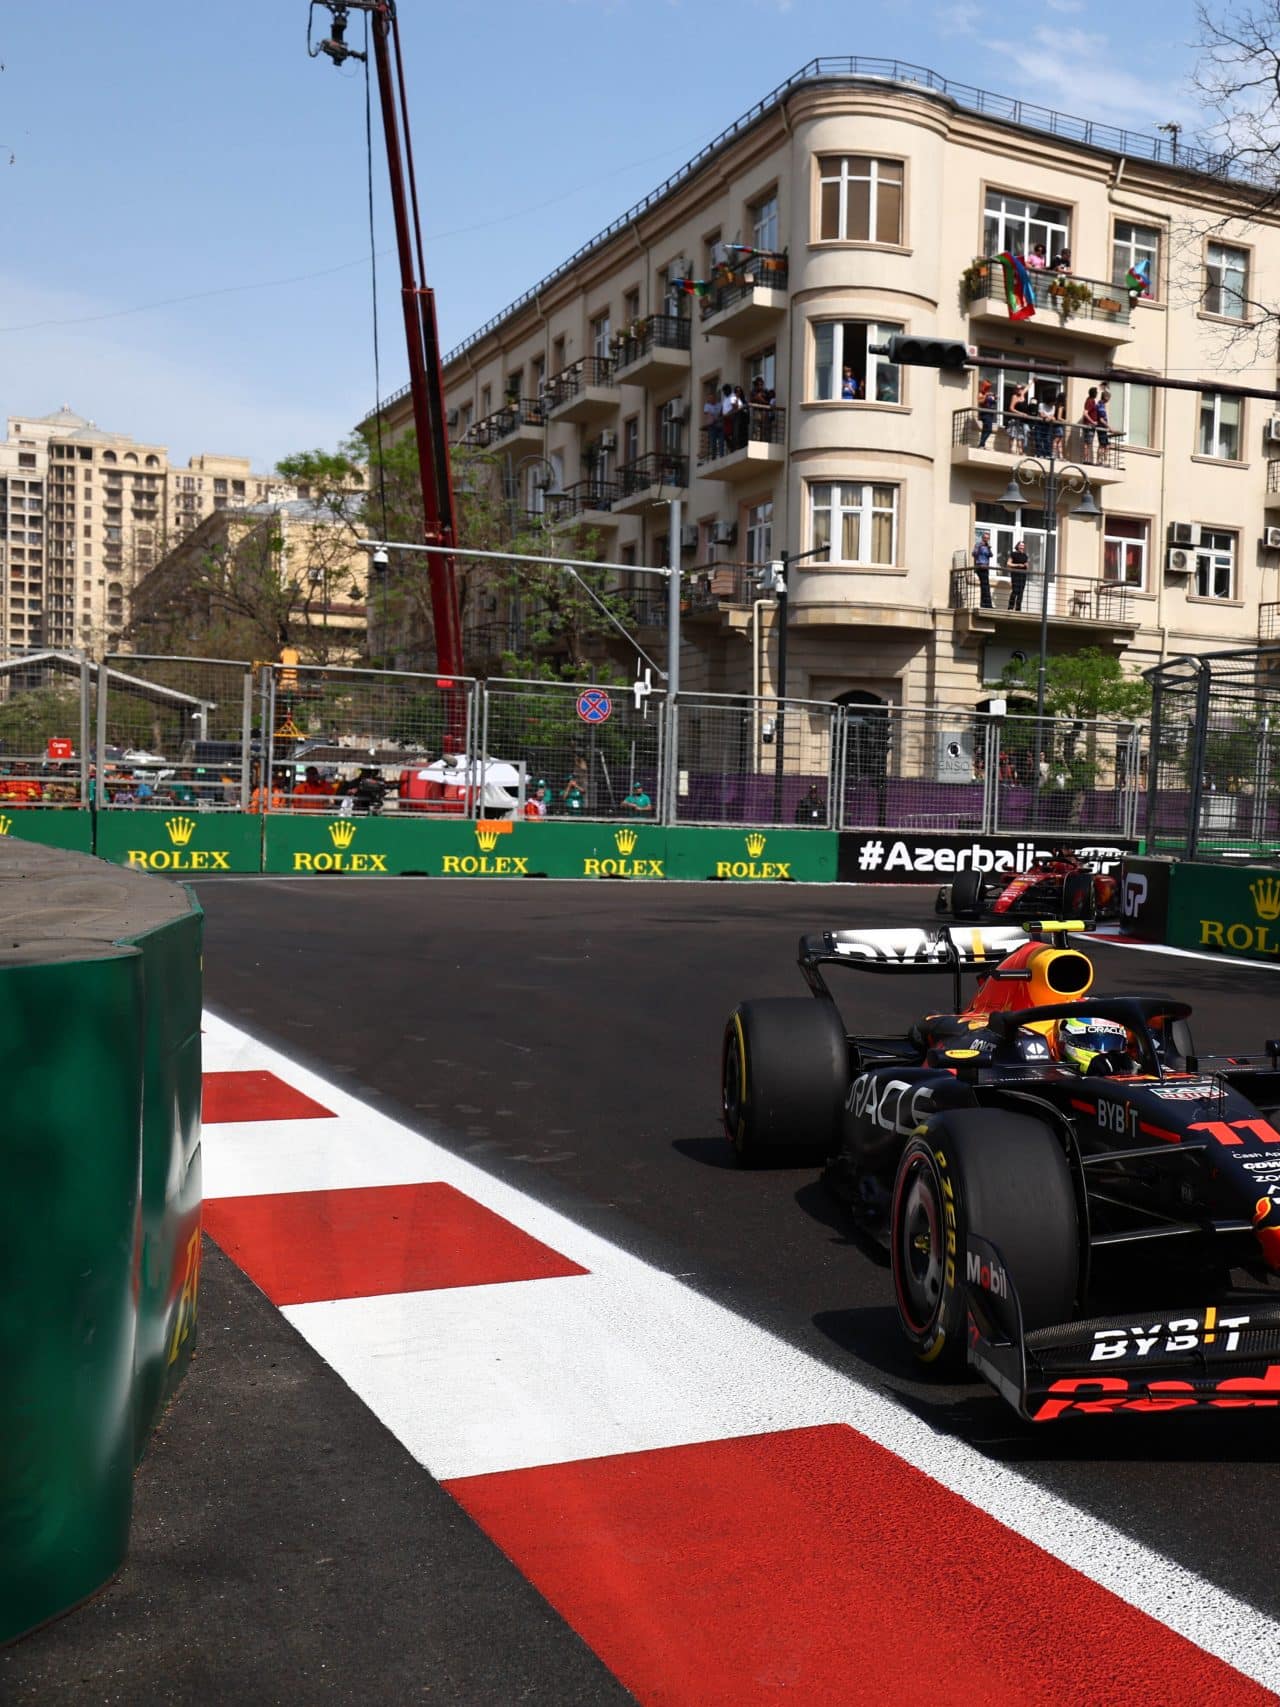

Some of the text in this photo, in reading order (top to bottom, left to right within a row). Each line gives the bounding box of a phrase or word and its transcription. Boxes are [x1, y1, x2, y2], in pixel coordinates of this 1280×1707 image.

[127, 850, 230, 869] ROLEX
[293, 853, 387, 872] ROLEX
[442, 856, 529, 875] ROLEX
[583, 856, 665, 877] ROLEX
[716, 862, 791, 879] ROLEX
[857, 840, 1056, 874] #Azerbaij
[1097, 1098, 1139, 1138] BYBIT
[940, 1176, 957, 1289] ZERO
[966, 1251, 1008, 1299] Mobil
[1090, 1307, 1250, 1361] BYBIT
